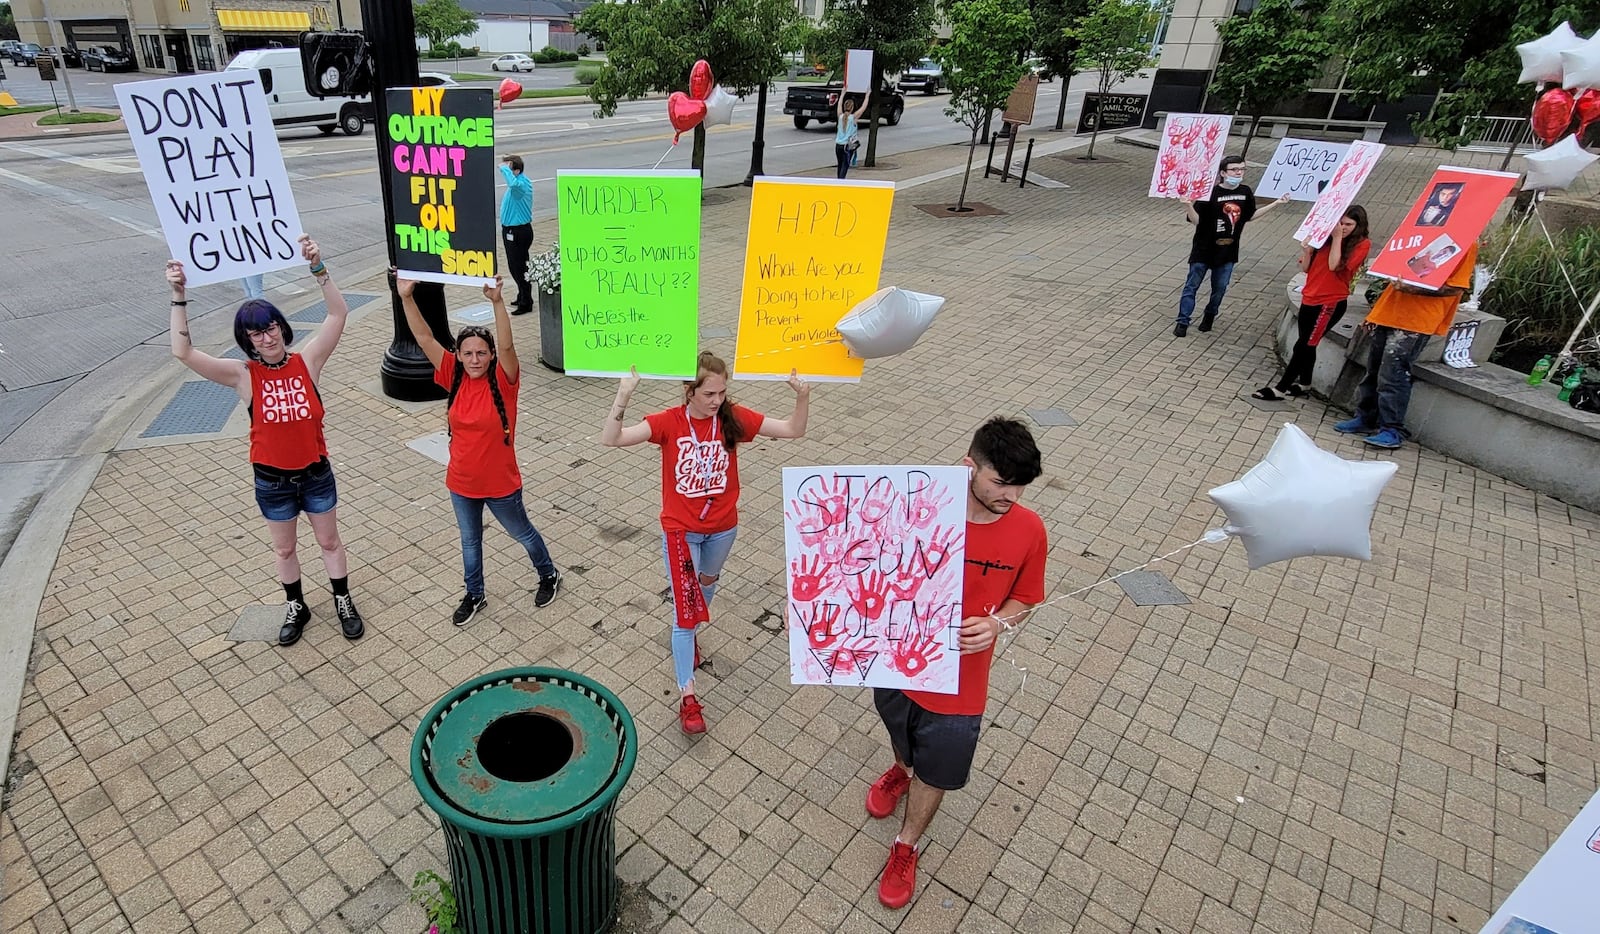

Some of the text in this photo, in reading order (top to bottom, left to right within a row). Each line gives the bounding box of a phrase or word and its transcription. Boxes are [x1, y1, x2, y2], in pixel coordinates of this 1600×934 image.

[130, 79, 255, 136] DON'T
[412, 87, 446, 117] MY
[1126, 97, 1141, 105] OF
[388, 114, 494, 147] OUTRAGE
[158, 131, 255, 183] PLAY
[393, 145, 465, 176] CANT
[1276, 143, 1338, 172] Justice
[410, 176, 457, 207] FIT
[1272, 171, 1315, 194] 4 JR
[168, 179, 277, 224] WITH
[567, 185, 668, 216] MURDER
[420, 203, 456, 232] ON
[189, 219, 294, 271] GUNS
[395, 224, 451, 256] THIS
[611, 246, 637, 264] 36
[1389, 235, 1423, 251] LL JR
[440, 248, 494, 278] SIGN
[758, 253, 799, 280] What
[756, 286, 798, 309] Doing
[820, 285, 855, 307] help
[754, 309, 805, 328] Prevent
[782, 326, 806, 343] Gun
[262, 376, 306, 395] OHIO
[262, 391, 310, 408] OHIO
[263, 405, 312, 423] OHIO
[796, 470, 931, 534] STOP
[840, 539, 950, 579] GUN
[791, 599, 963, 652] VIOLENCE
